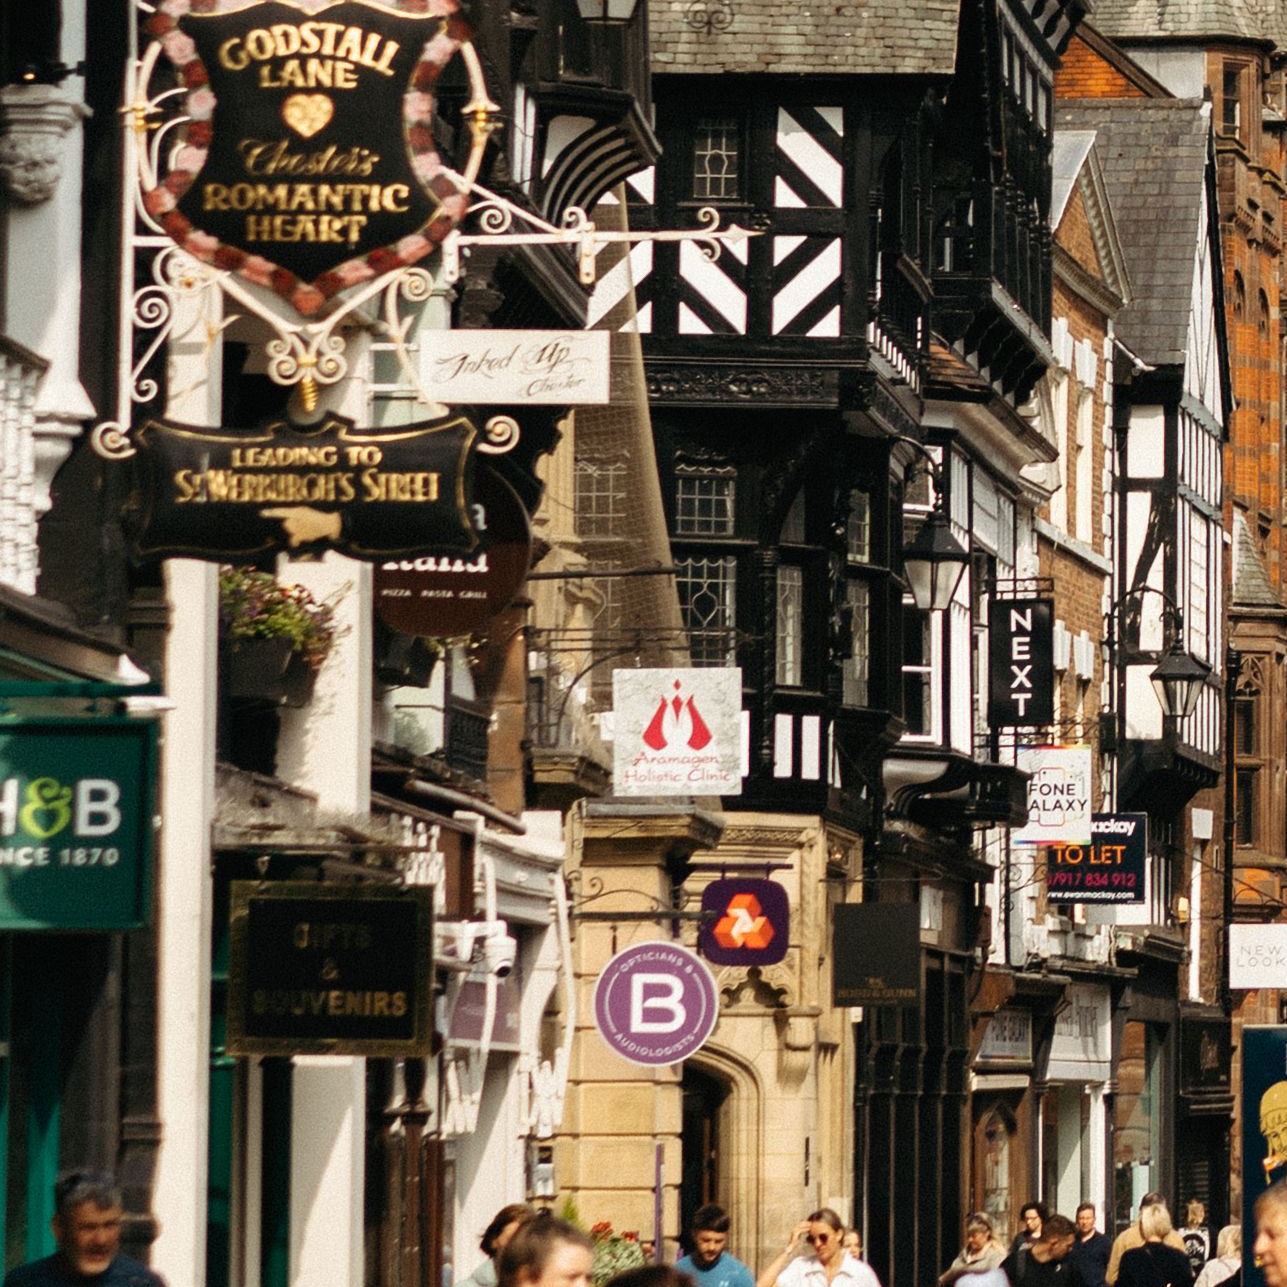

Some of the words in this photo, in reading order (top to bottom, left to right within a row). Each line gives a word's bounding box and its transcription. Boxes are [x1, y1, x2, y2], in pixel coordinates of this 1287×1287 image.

[218, 21, 400, 76] GODSTALL
[259, 58, 360, 89] LANE
[238, 138, 380, 177] Chester's
[203, 183, 410, 212] ROMANTIC
[246, 214, 367, 243] HEART
[231, 446, 338, 467] LEADING
[344, 446, 383, 466] TO
[361, 469, 440, 502] STREET
[381, 589, 412, 597] PIZZA
[1009, 608, 1032, 717] NEXT
[632, 752, 720, 768] Aramagen
[623, 769, 681, 783] Holistic
[687, 768, 732, 782] Clinic
[1029, 783, 1076, 796] FONE
[1030, 799, 1088, 812] ALAXY
[60, 846, 119, 867] 1870
[1053, 844, 1083, 864] TO
[1090, 845, 1126, 864] LET
[1112, 873, 1136, 887] 912
[1239, 945, 1282, 956] NEW
[320, 958, 341, 982] &
[620, 951, 684, 973] OPTICIANS
[1236, 957, 1287, 967] LOOK
[630, 973, 687, 1033] B
[614, 1033, 695, 1057] AUDIOLOGISTS
